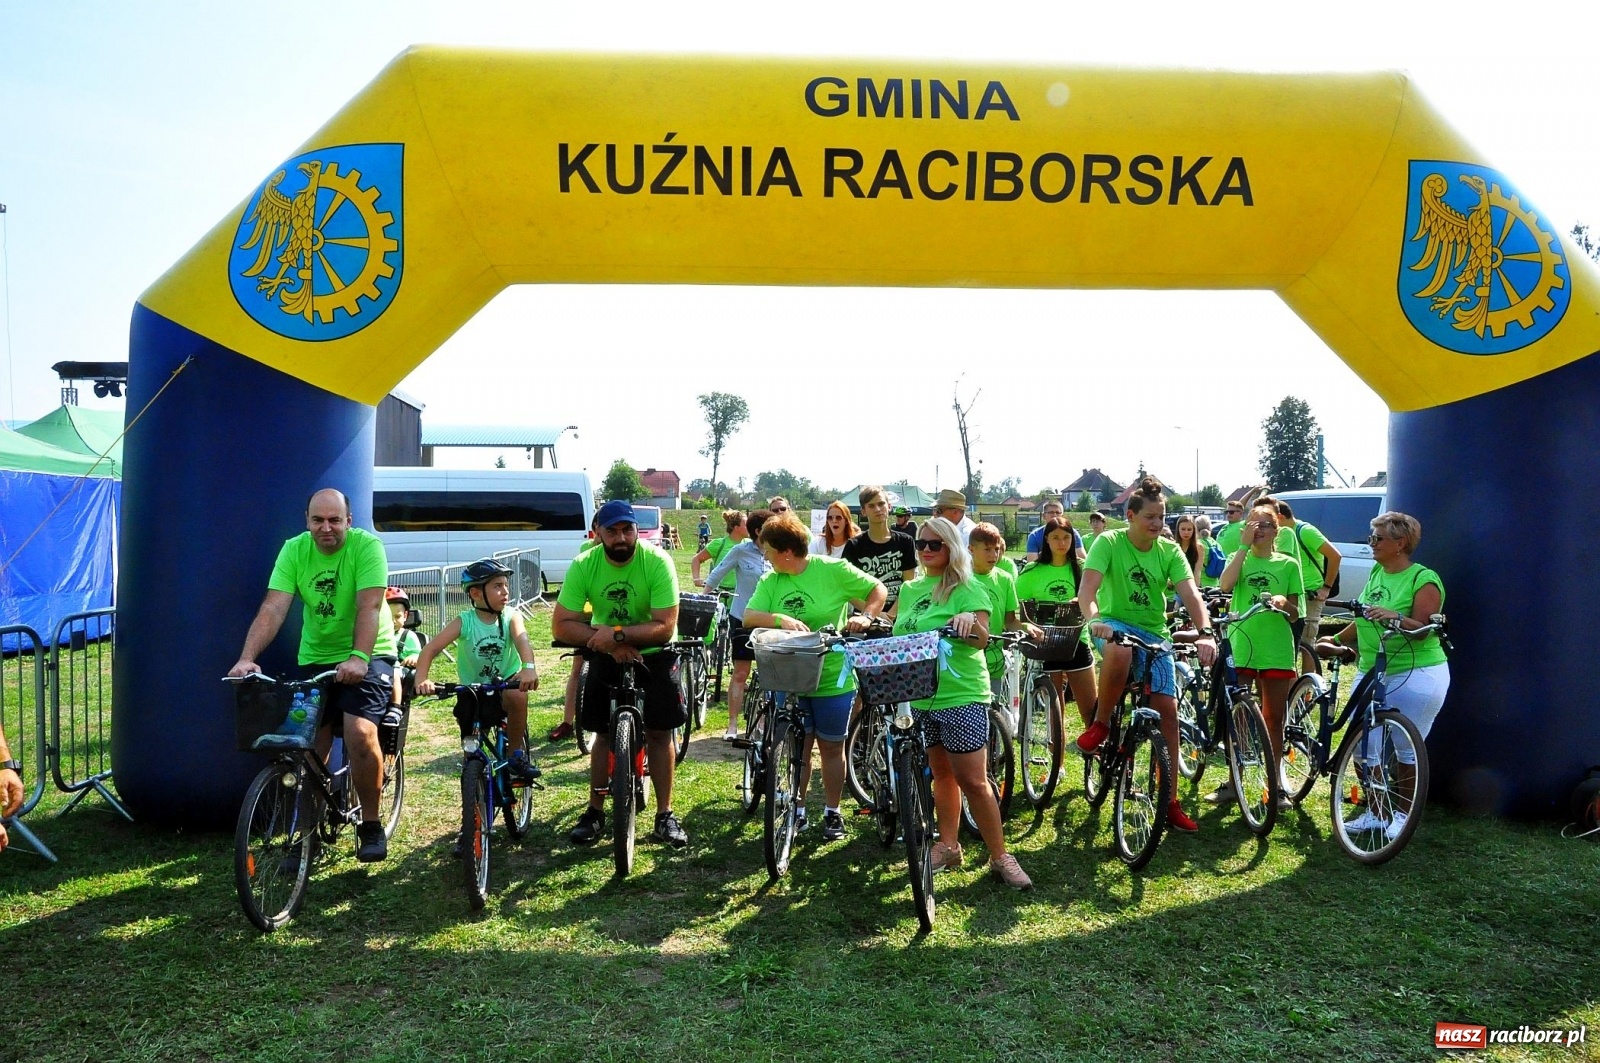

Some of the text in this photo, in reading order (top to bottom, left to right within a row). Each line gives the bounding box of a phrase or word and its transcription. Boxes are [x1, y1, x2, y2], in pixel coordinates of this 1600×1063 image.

[805, 77, 1020, 120] GMINA
[558, 132, 1253, 207] KUŹNIA RACIBORSKA
